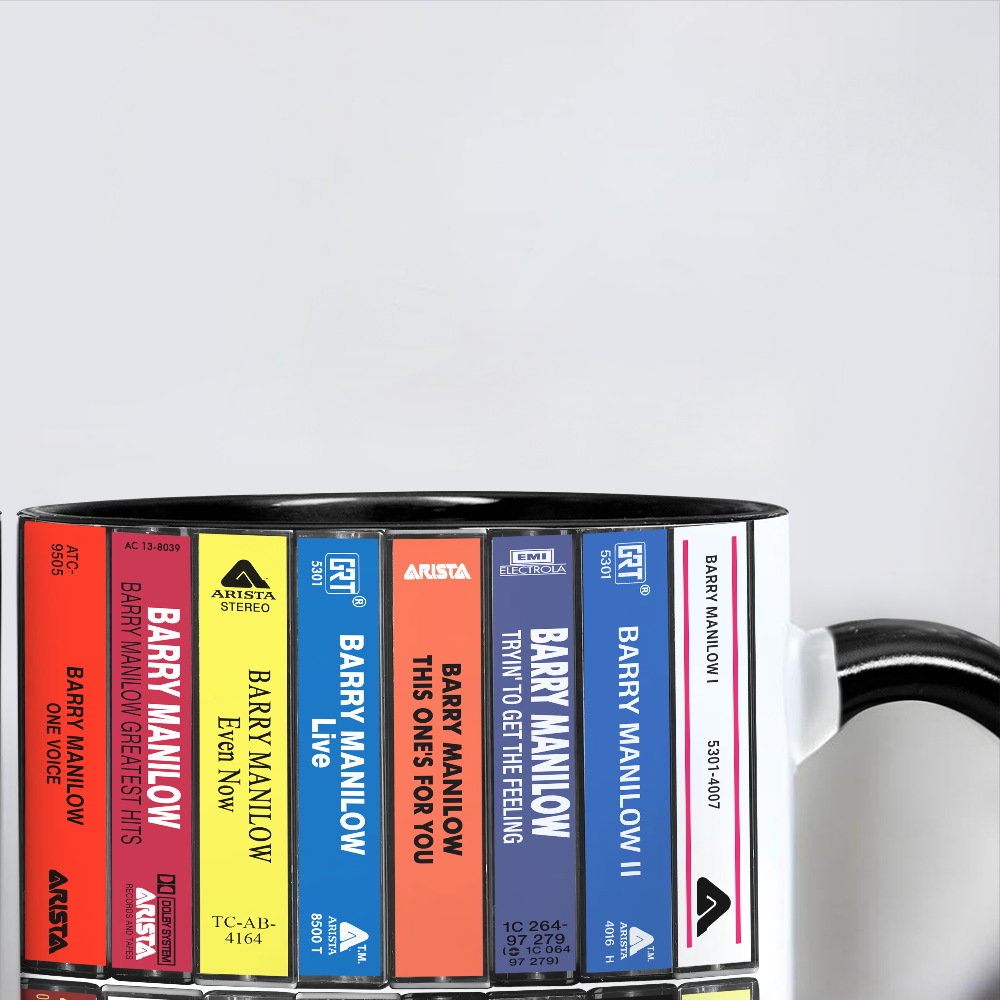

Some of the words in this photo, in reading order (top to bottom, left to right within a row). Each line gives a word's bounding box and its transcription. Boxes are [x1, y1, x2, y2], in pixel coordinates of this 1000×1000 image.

[51, 544, 63, 575] 9505
[142, 542, 180, 552] 13-8039
[706, 555, 717, 601] BARRY
[121, 582, 141, 636] BARRY
[502, 630, 522, 680] TRYIN'
[706, 607, 718, 674] MANILOW
[121, 641, 141, 716] MANILOW
[413, 655, 433, 700] THIS
[619, 626, 639, 714] BARRY
[502, 684, 522, 704] TO
[47, 703, 61, 734] ONE
[218, 716, 240, 762] Even
[413, 708, 433, 767] ONE'S
[502, 710, 522, 739] GET
[47, 740, 61, 784] VOICE
[121, 722, 142, 805] GREATEST
[312, 719, 336, 768] Live
[503, 743, 522, 774] THE
[218, 769, 240, 812] Now
[413, 776, 433, 815] FOR
[619, 723, 640, 852] MANILOW
[708, 741, 720, 809] 5301-4007
[121, 810, 142, 844] HITS
[503, 779, 523, 843] FEELING
[414, 820, 433, 864] YOU
[621, 862, 641, 876] II
[49, 869, 68, 955] ARISTA
[225, 932, 262, 944] 4164
